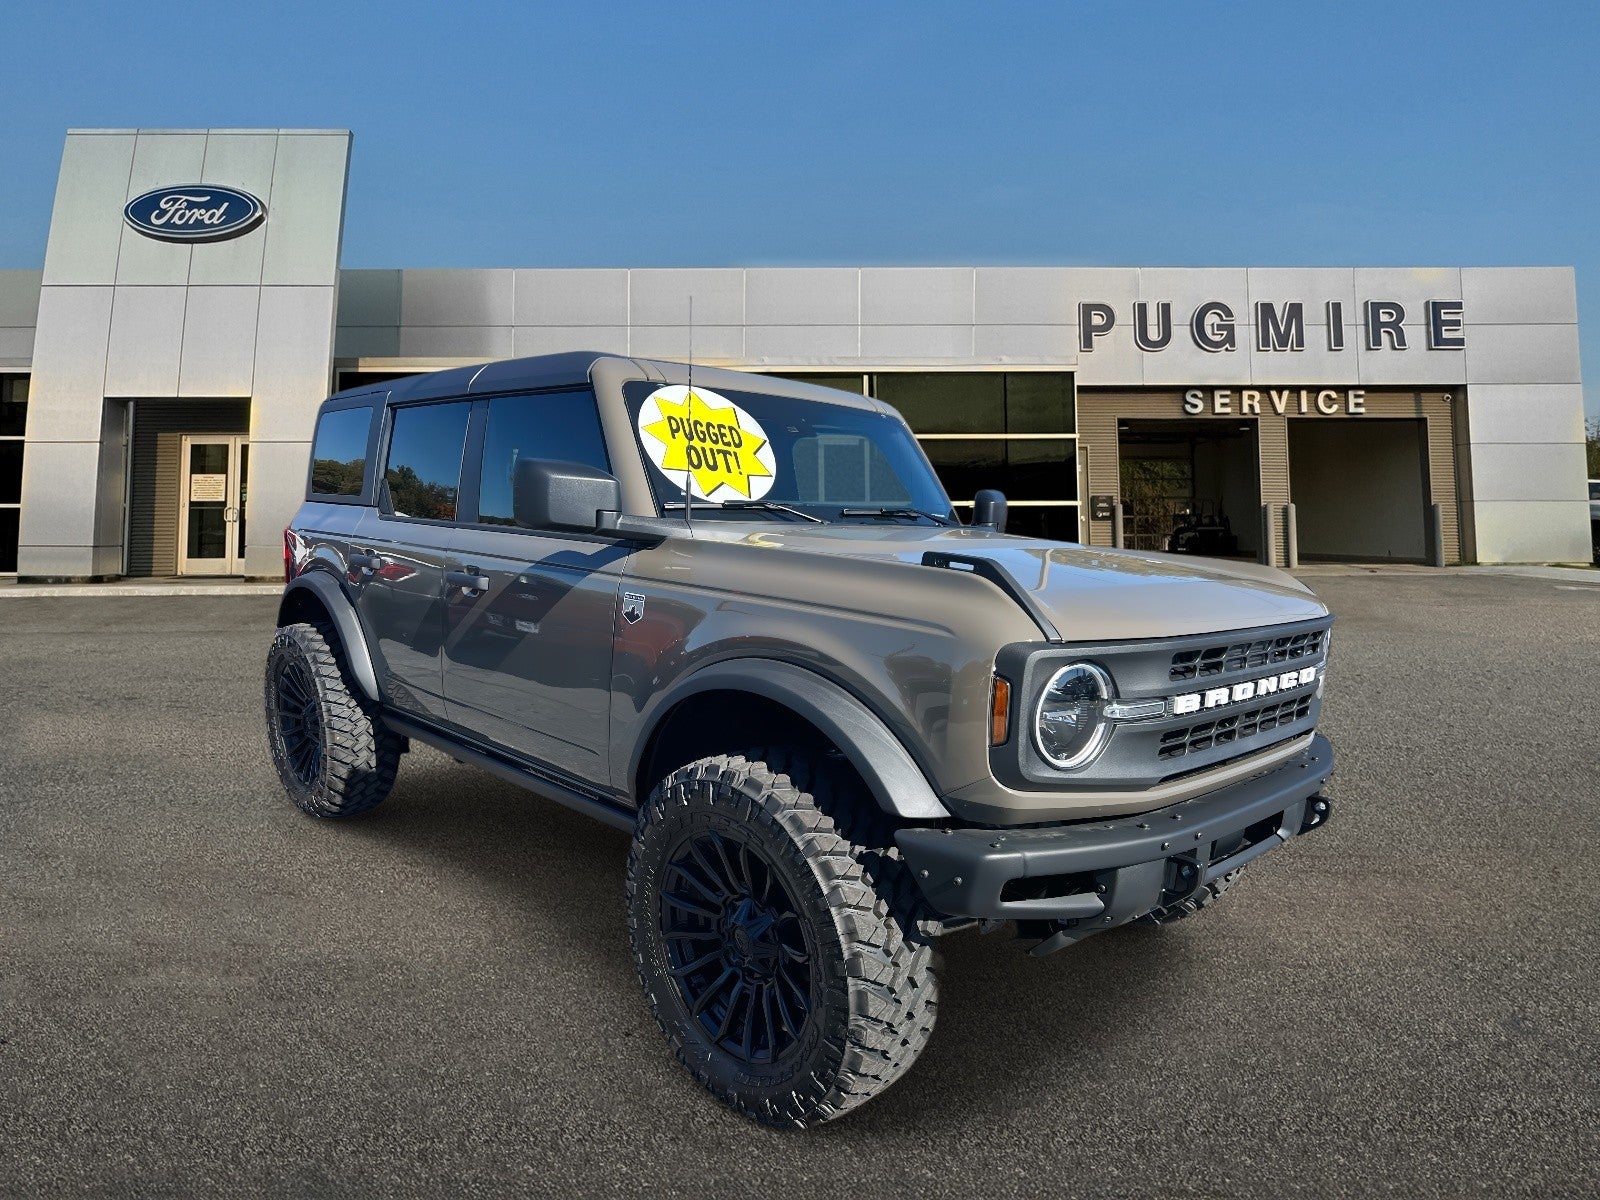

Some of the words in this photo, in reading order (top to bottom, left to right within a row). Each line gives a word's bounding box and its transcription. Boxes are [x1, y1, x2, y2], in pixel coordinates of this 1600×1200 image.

[150, 195, 230, 225] Ford
[1078, 300, 1467, 352] PUGMIRE
[1183, 389, 1367, 416] SERVICE
[666, 415, 743, 449] PUGGED
[686, 444, 743, 475] OUT!
[1173, 666, 1318, 715] BRONCO
